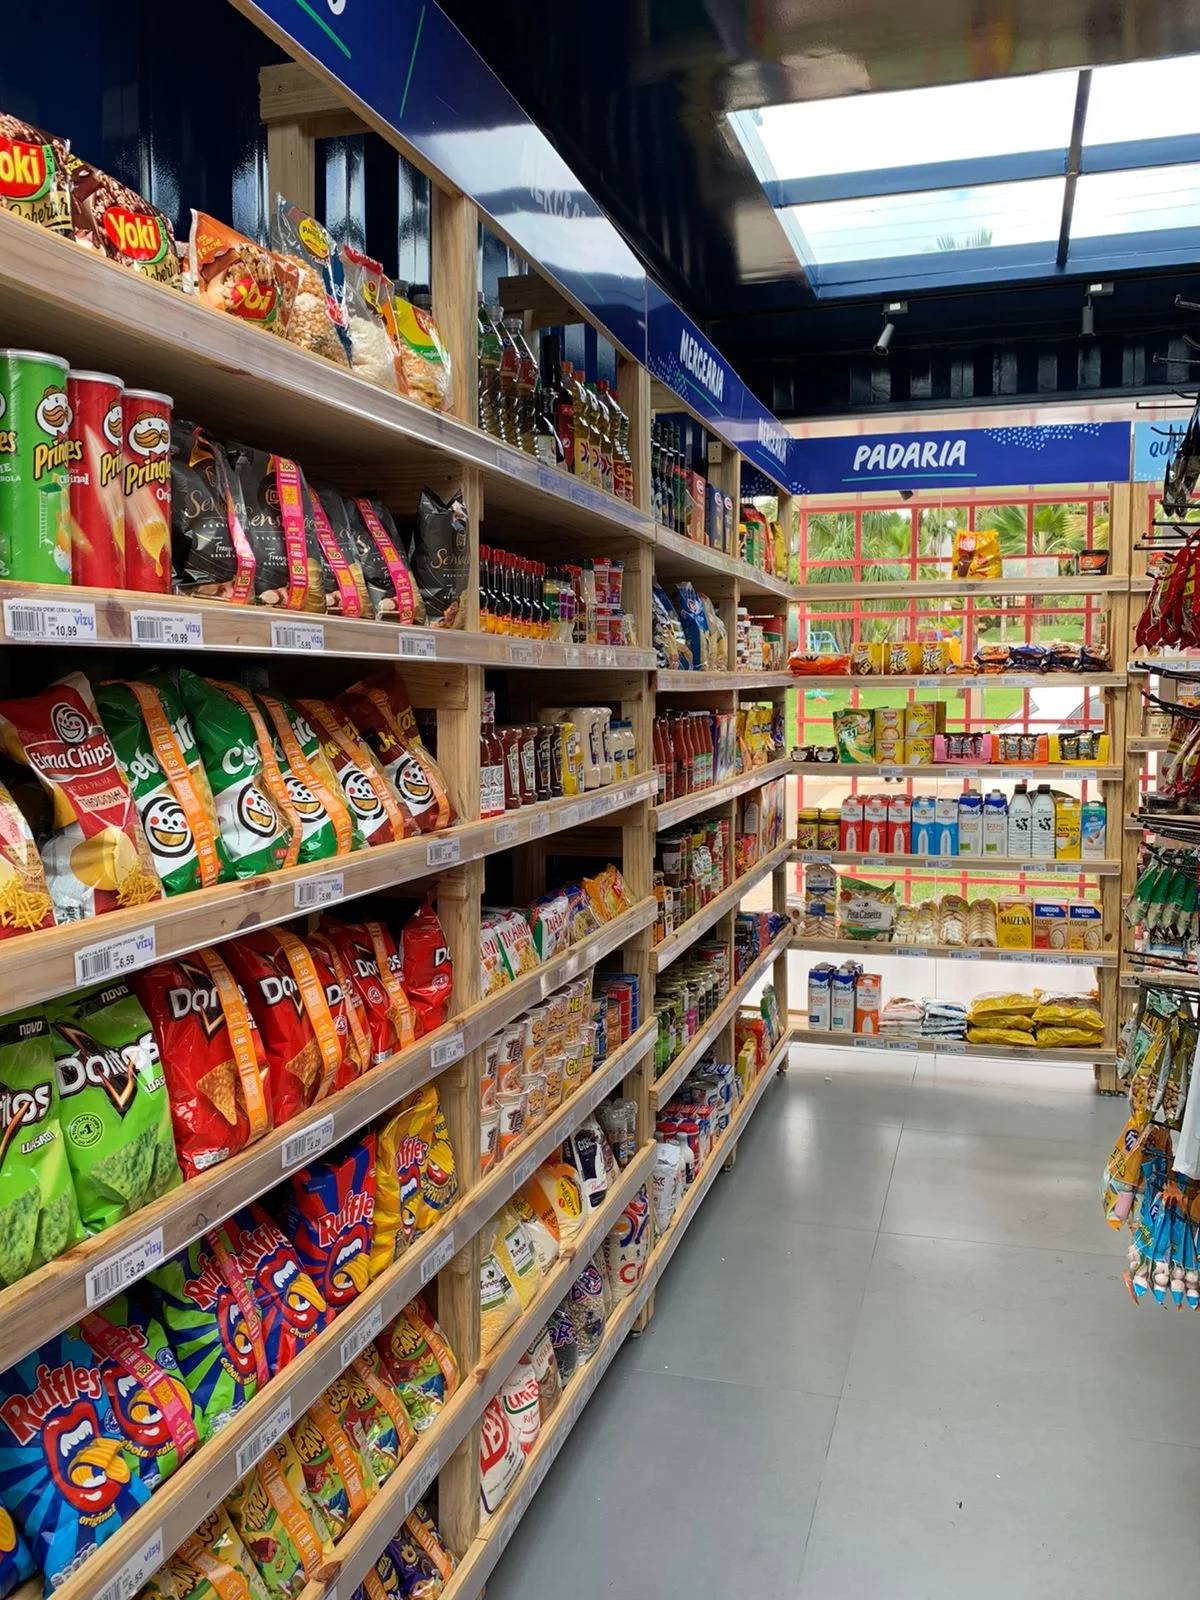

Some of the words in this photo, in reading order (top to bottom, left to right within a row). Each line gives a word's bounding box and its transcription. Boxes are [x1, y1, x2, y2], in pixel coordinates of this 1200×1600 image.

[0, 146, 40, 185] oki
[107, 213, 158, 250] Yoki
[679, 328, 725, 402] MERCEARIA
[0, 430, 16, 454] es
[757, 417, 788, 466] MERCEARIA
[852, 440, 968, 471] PADARIA
[56, 625, 77, 638] 10,99
[74, 613, 94, 631] vizy
[185, 622, 200, 638] vizy
[1057, 825, 1080, 833] NINHO
[1000, 916, 1031, 926] MAIZENA
[135, 937, 153, 951] vizy
[119, 954, 135, 968] 6,59
[55, 1032, 160, 1096] Doritos
[144, 1240, 161, 1257] vizy
[1, 1361, 101, 1446] Ruffles
[79, 1503, 117, 1528] original
[144, 1540, 161, 1562] vizy
